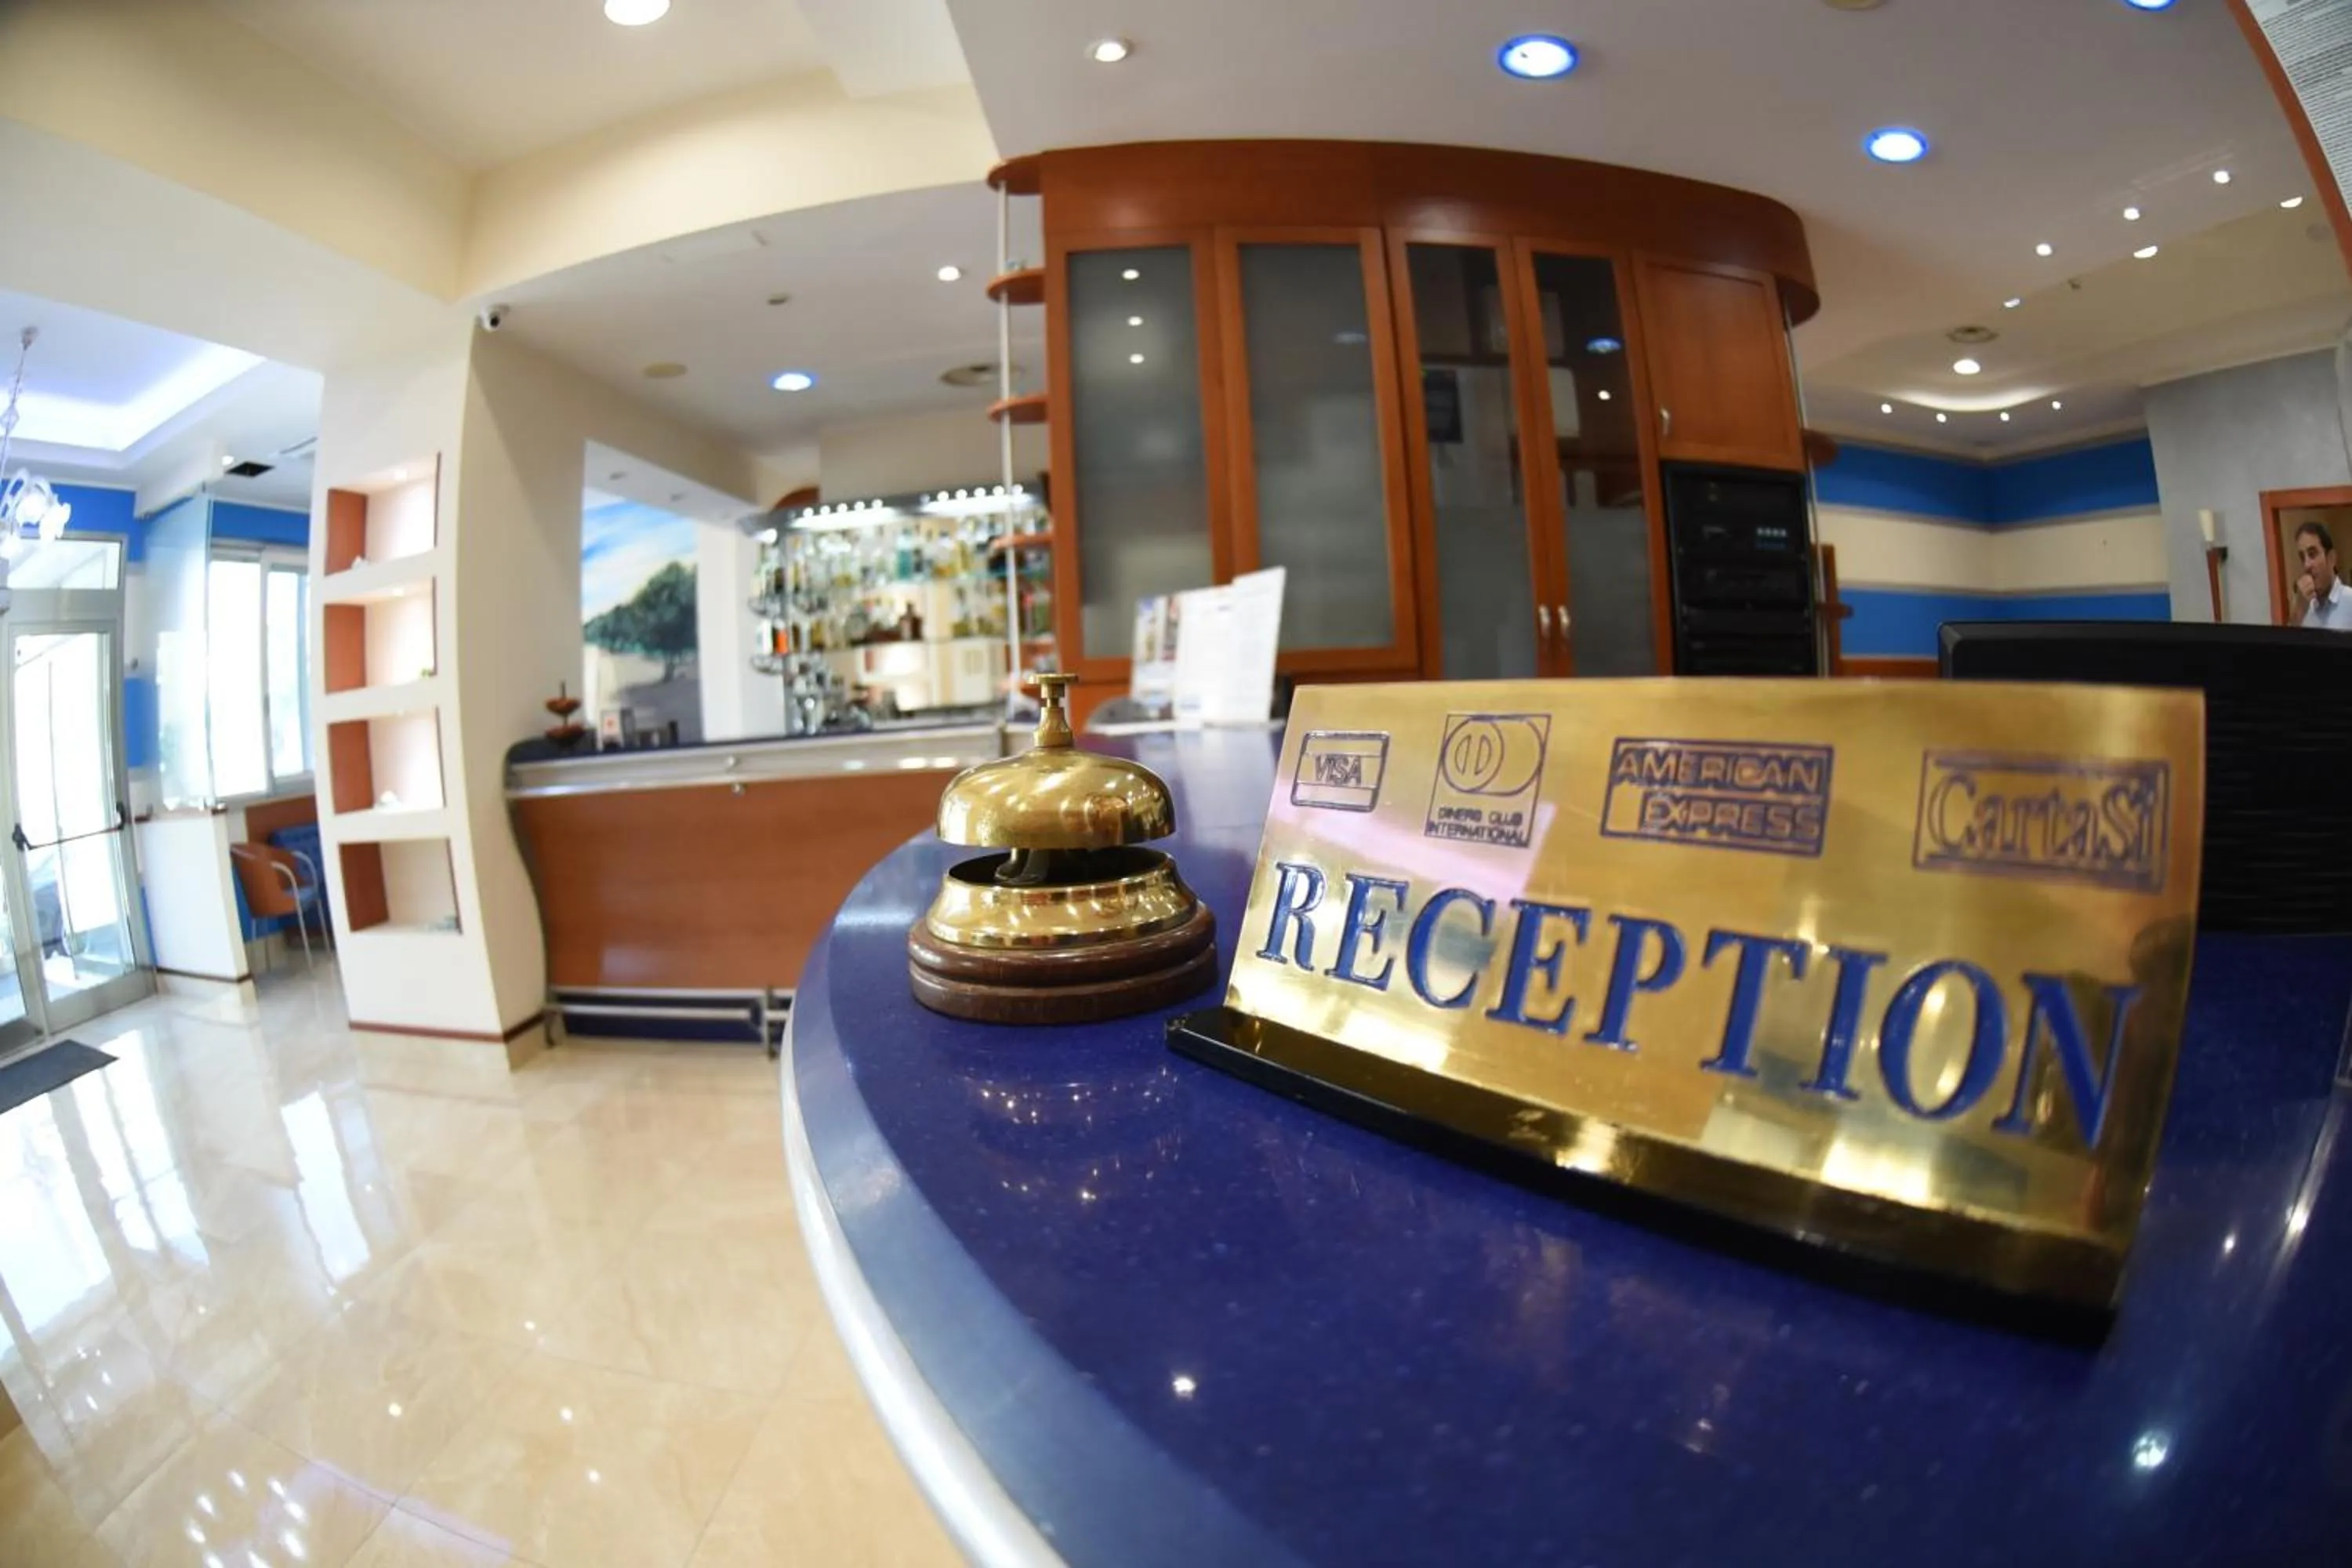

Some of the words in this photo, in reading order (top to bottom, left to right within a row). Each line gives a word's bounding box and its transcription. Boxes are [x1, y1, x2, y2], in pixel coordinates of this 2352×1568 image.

[1314, 753, 1363, 785] VISA
[1615, 748, 1821, 794] AMERICAN
[1427, 820, 1528, 846] INTERNATIONAL
[1643, 794, 1820, 841] EXPRESS
[1256, 861, 2141, 1149] RECEPTION
